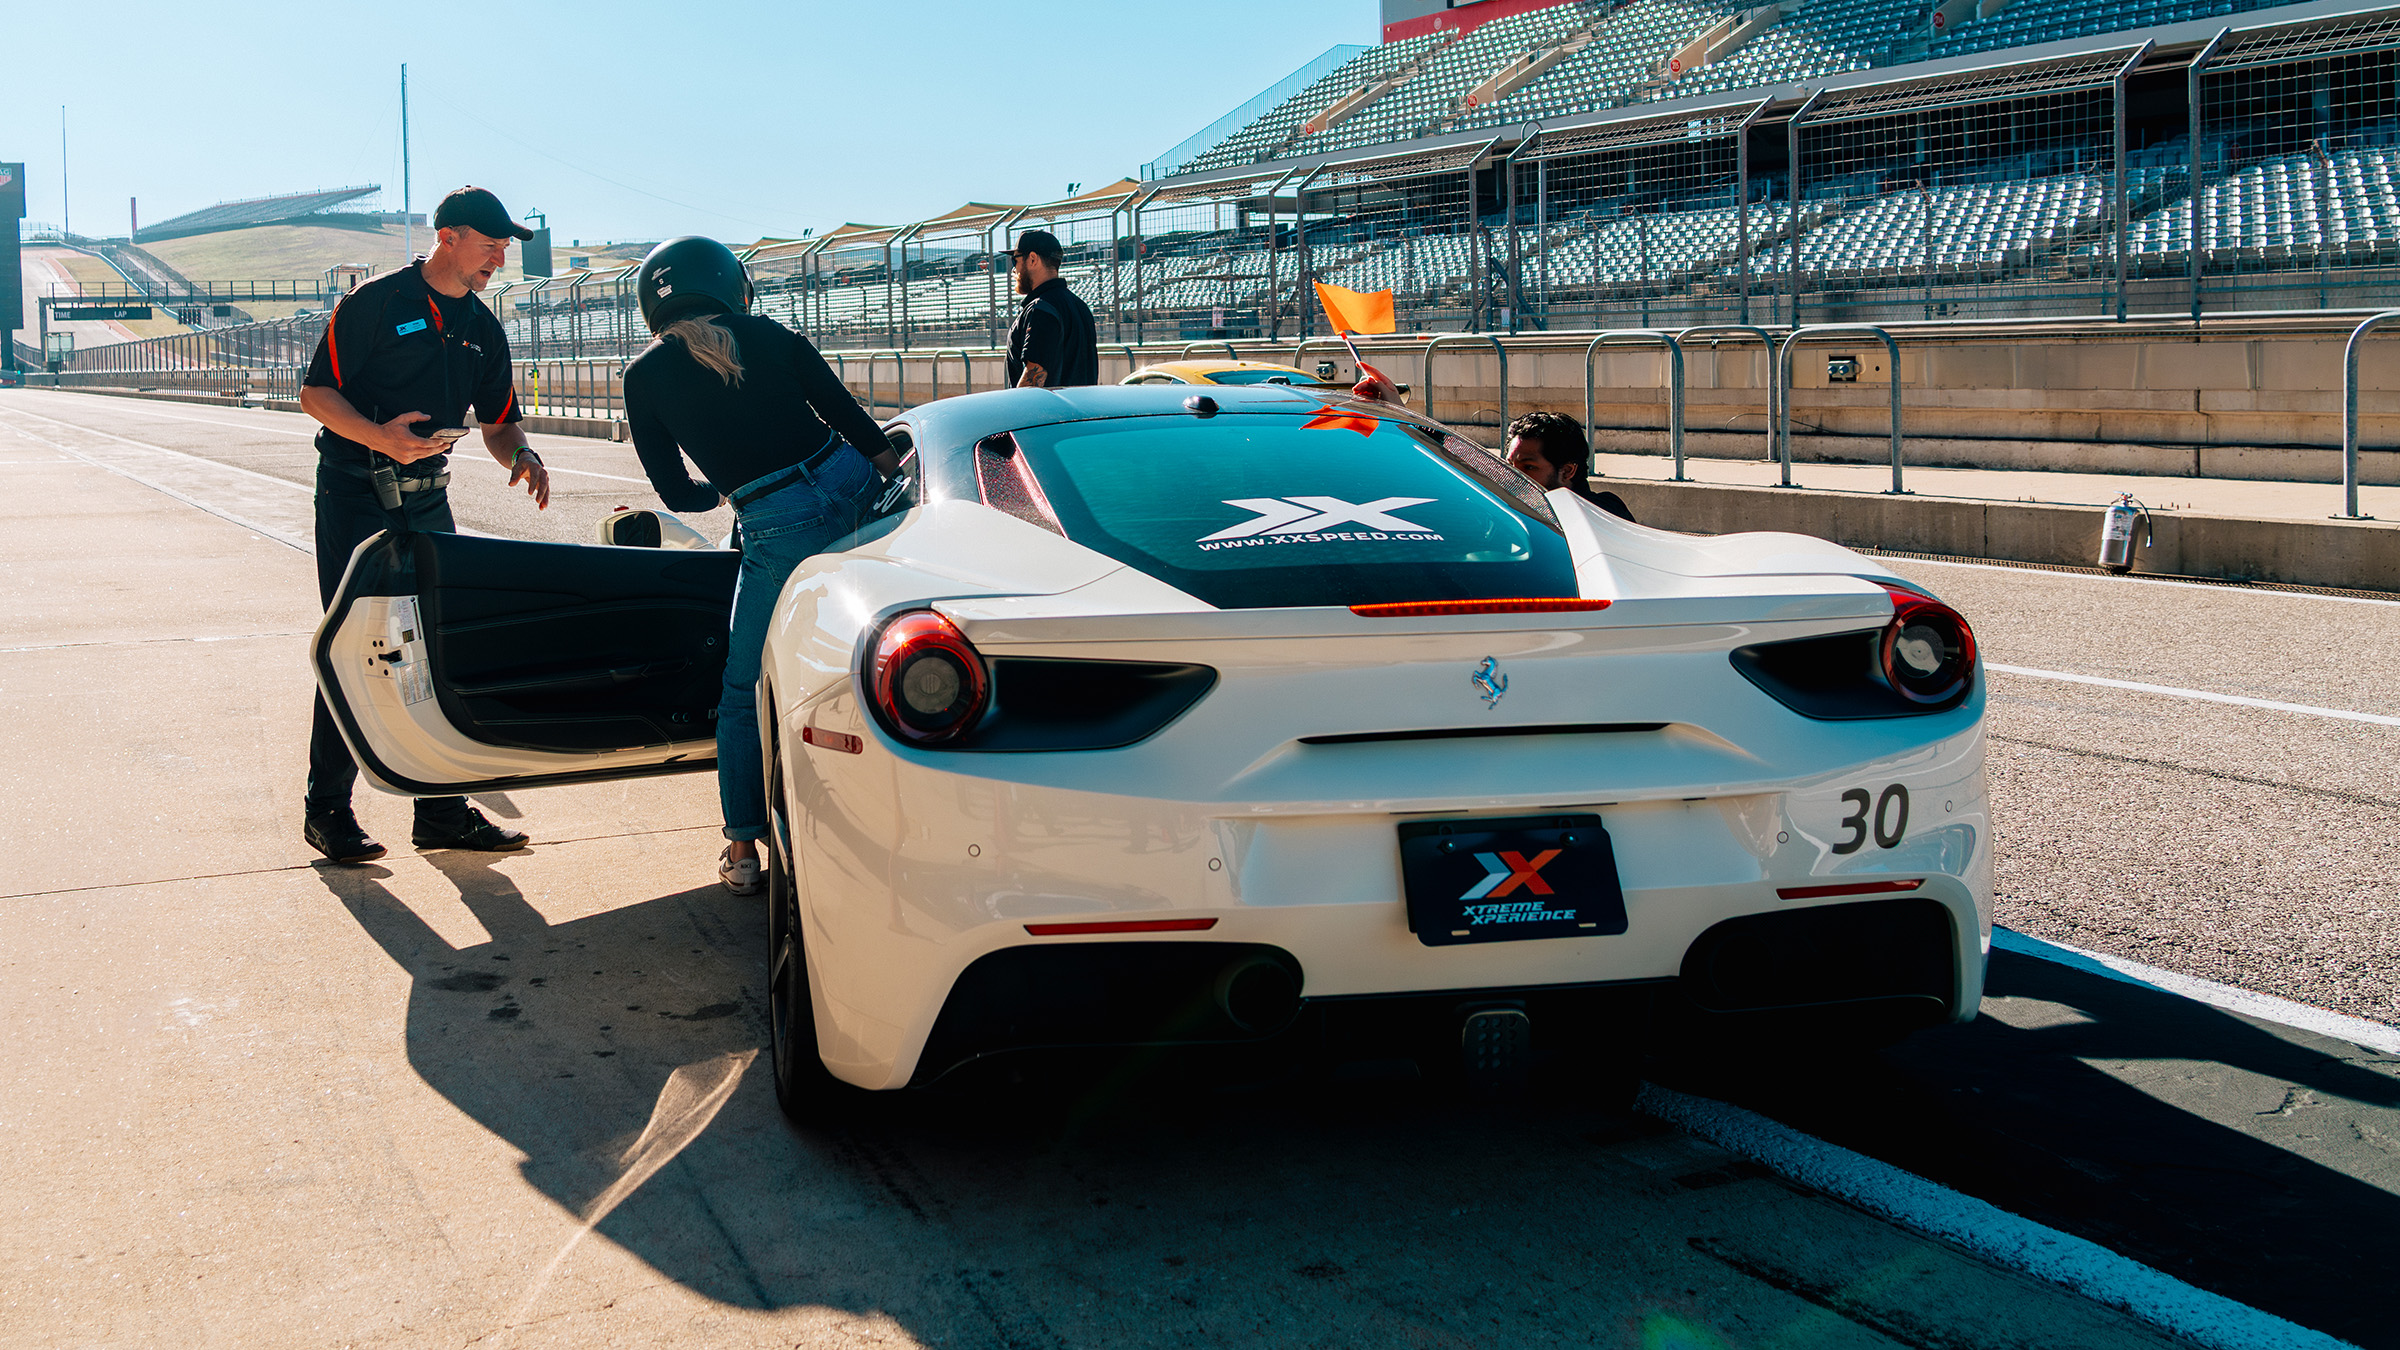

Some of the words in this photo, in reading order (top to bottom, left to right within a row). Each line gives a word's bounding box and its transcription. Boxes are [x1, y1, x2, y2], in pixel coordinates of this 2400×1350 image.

[54, 311, 71, 319] TIME
[114, 310, 127, 318] LAP
[873, 475, 911, 513] 30
[1198, 531, 1444, 551] WWW.XXSPEED.COM
[1832, 783, 1909, 855] 30
[1462, 901, 1545, 916] XTREME
[1471, 909, 1577, 925] XPERIENCE
